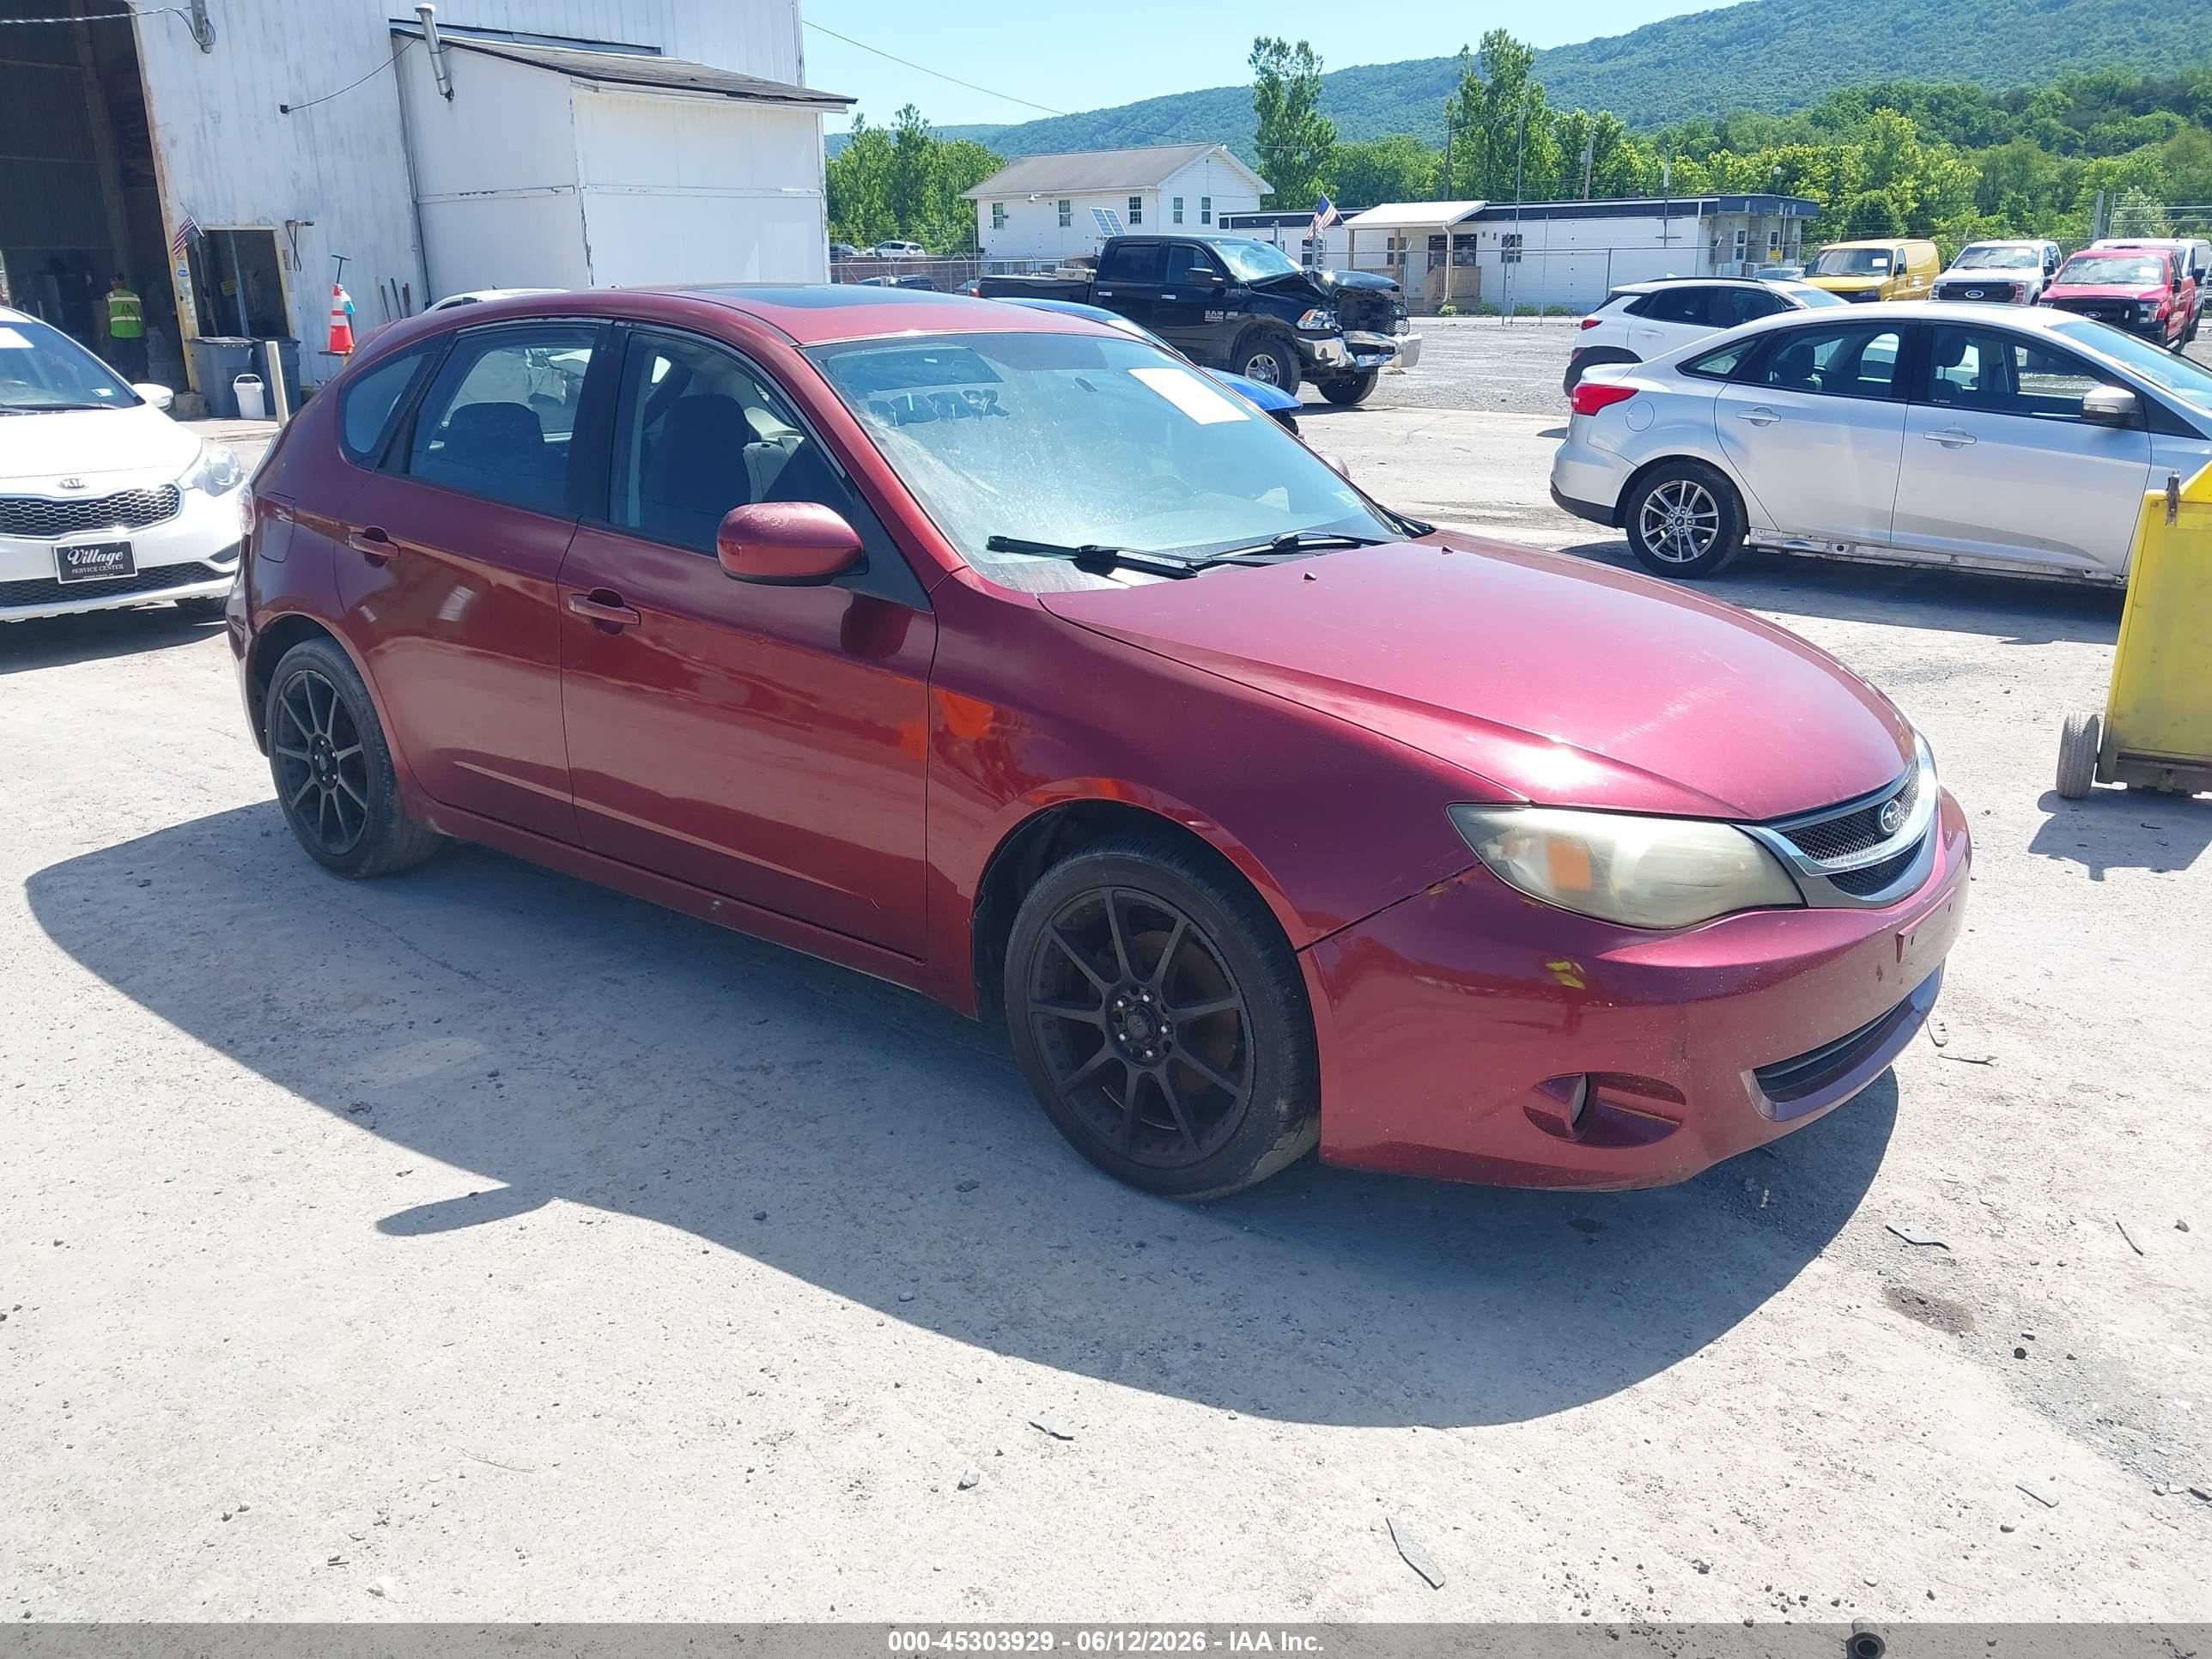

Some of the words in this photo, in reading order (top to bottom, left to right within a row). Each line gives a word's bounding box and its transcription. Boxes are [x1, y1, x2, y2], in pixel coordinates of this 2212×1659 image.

[67, 549, 124, 566] Village
[71, 566, 98, 574] SERVICE
[99, 563, 125, 572] CENTER
